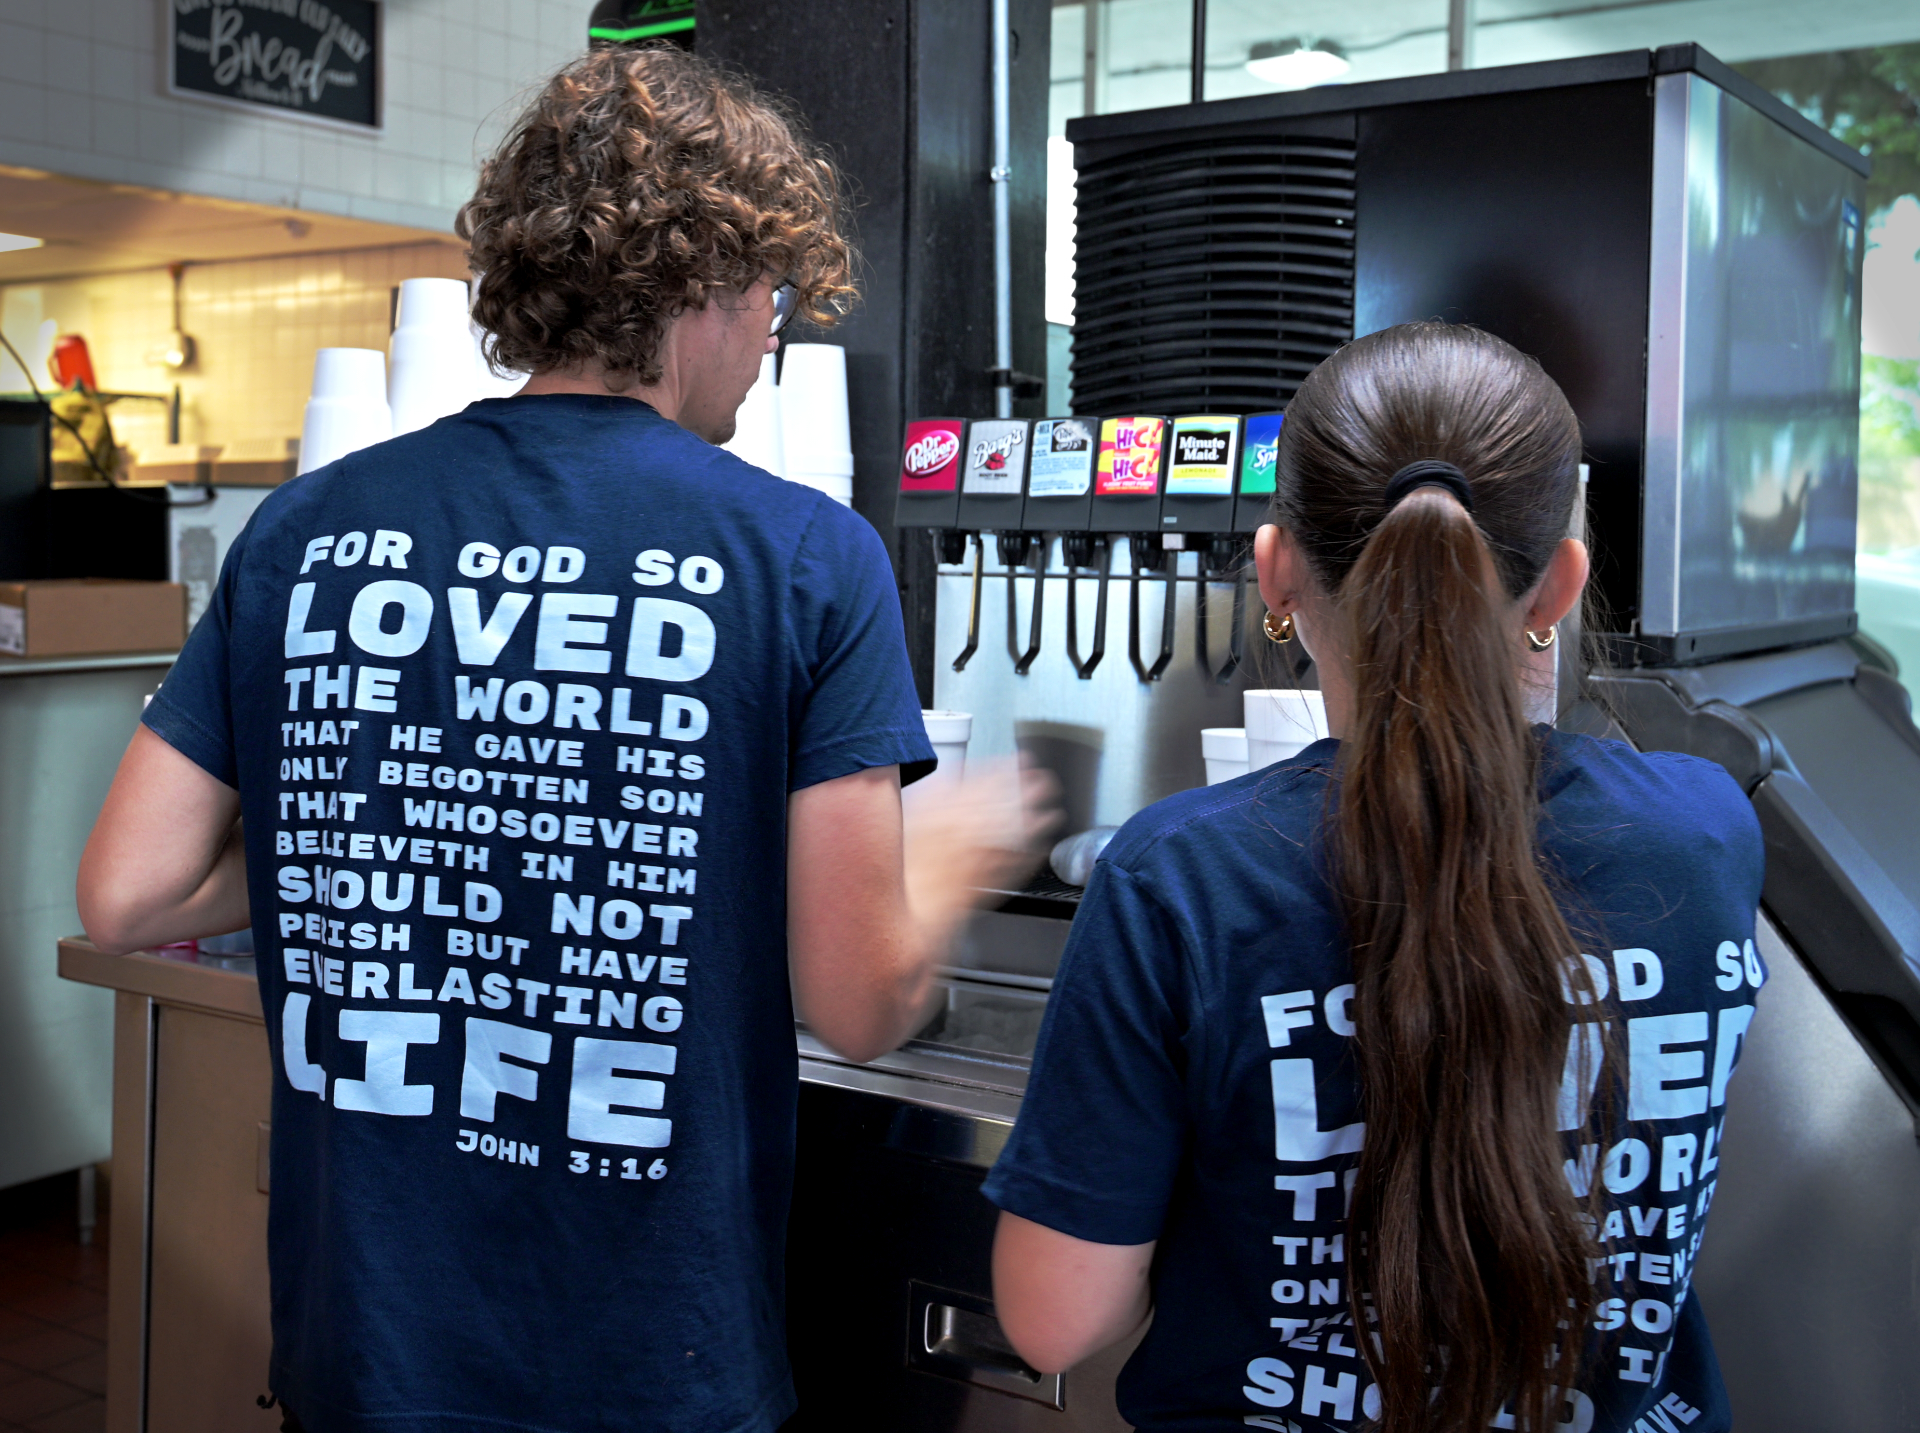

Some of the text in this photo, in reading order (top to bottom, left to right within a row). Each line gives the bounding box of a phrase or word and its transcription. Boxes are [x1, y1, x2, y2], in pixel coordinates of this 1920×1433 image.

[209, 8, 336, 102] Bread
[911, 441, 954, 473] Pepper
[922, 435, 942, 452] Dr
[1179, 436, 1225, 450] Minute
[1183, 448, 1217, 461] Maid
[300, 529, 724, 595] FOR GOD SO
[284, 580, 717, 682] LOVED
[284, 665, 709, 742] THE WORLD
[281, 720, 706, 780] THAT HE GAVE HIS
[280, 757, 704, 816] ONLY BEGOTTEN SON
[278, 792, 699, 857] THAT WHOSOEVER
[276, 831, 697, 894] BELIEVETH IN HIM
[277, 866, 693, 945] SHOULD NOT
[447, 929, 529, 965] BUT
[560, 946, 688, 985] HAVE
[283, 948, 684, 1033] EVERLASTING
[1261, 984, 1356, 1048] FO
[1559, 948, 1663, 1005] OD
[282, 992, 677, 1148] LIFE
[456, 1129, 668, 1180] JOHN 3:16
[1563, 1116, 1726, 1198] WORL
